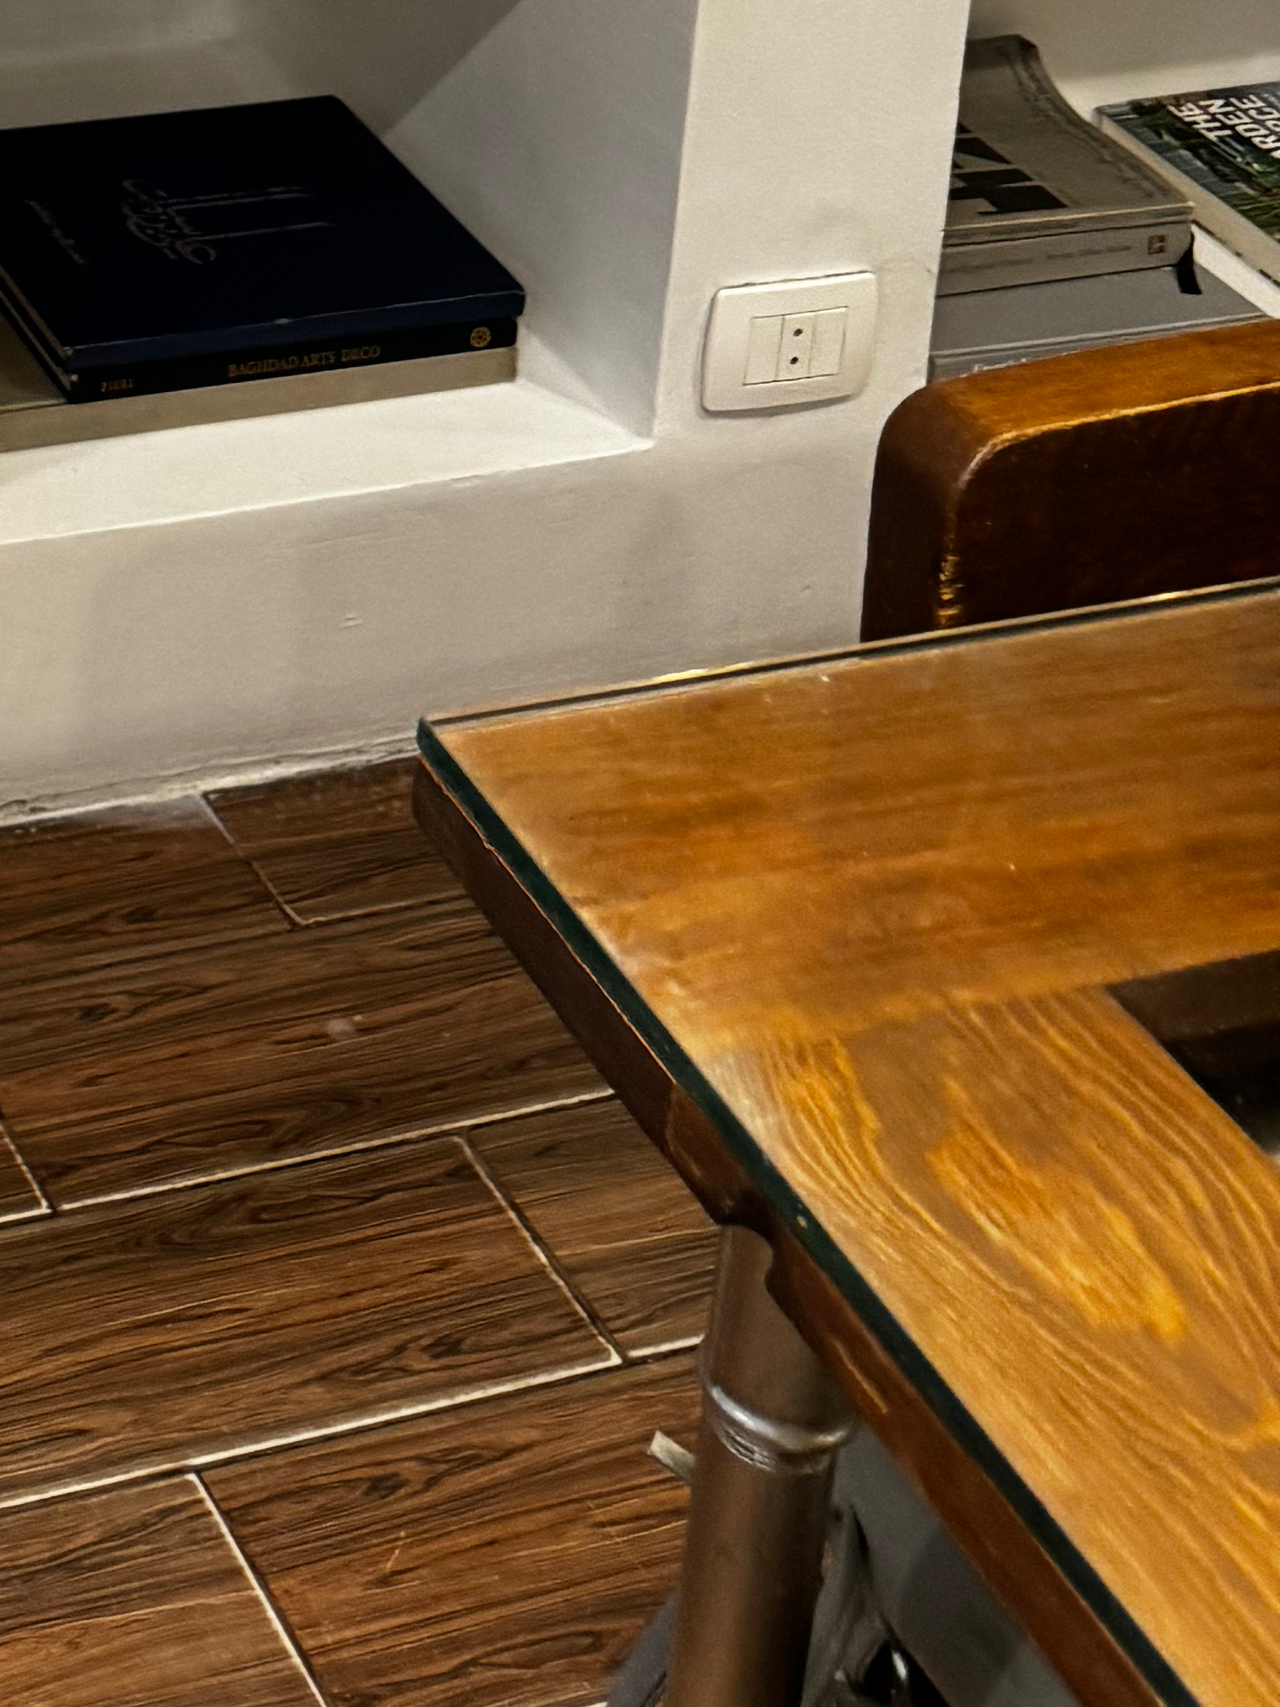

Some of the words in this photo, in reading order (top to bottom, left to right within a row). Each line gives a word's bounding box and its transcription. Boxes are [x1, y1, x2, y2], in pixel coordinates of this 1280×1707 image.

[1166, 102, 1233, 143] THE
[227, 354, 299, 378] BAGHDAD
[299, 350, 337, 370] ARTS
[341, 344, 382, 362] DECO
